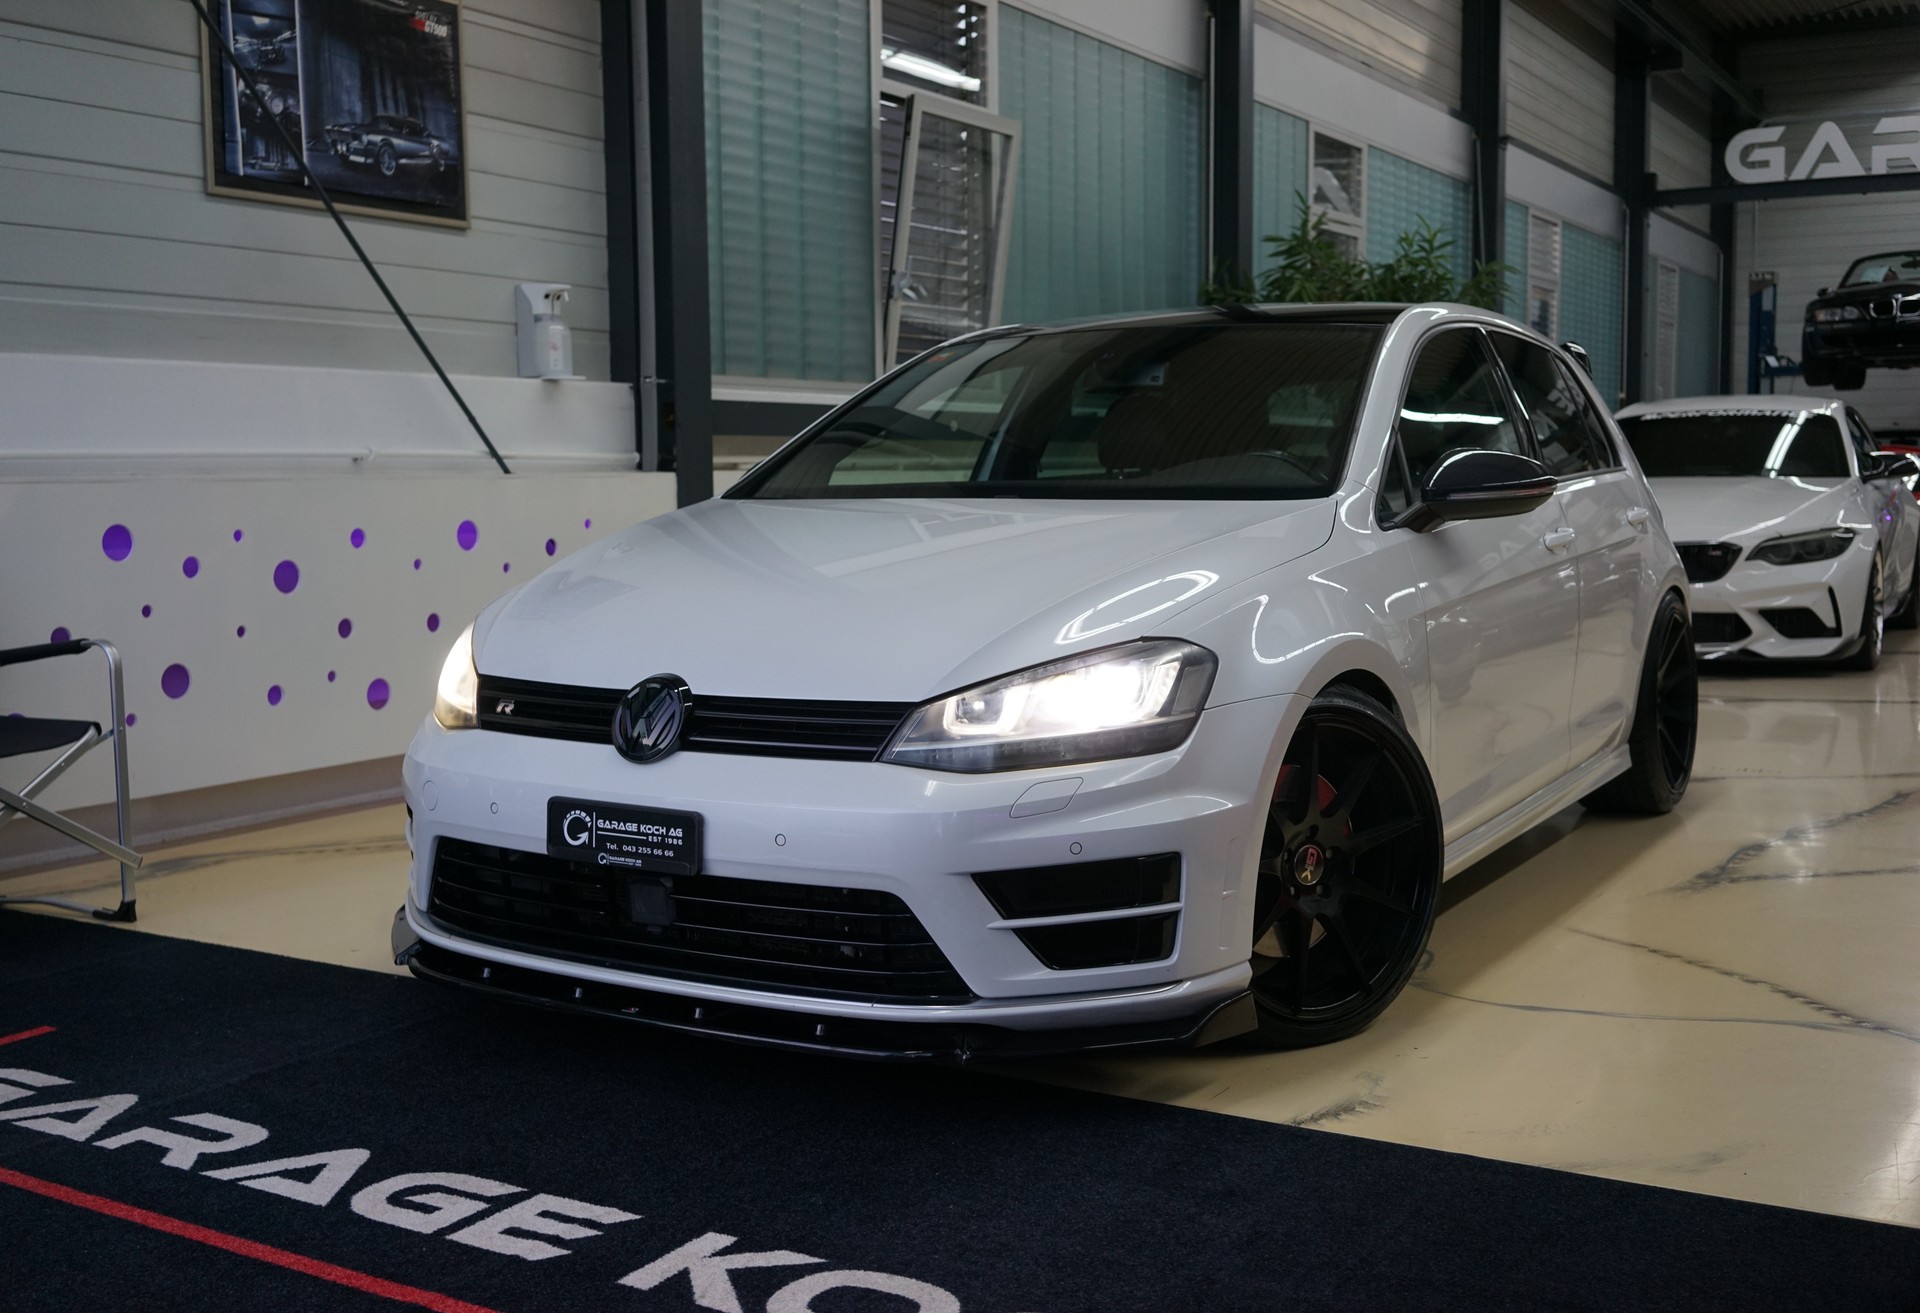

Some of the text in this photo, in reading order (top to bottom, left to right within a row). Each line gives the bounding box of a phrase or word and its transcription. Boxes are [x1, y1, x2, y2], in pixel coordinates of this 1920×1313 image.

[495, 698, 515, 715] R
[597, 819, 683, 838] GARAGE KOCH AG
[606, 842, 619, 851] Tel.
[622, 844, 636, 853] 043
[638, 846, 651, 854] 255
[664, 849, 674, 857] 66
